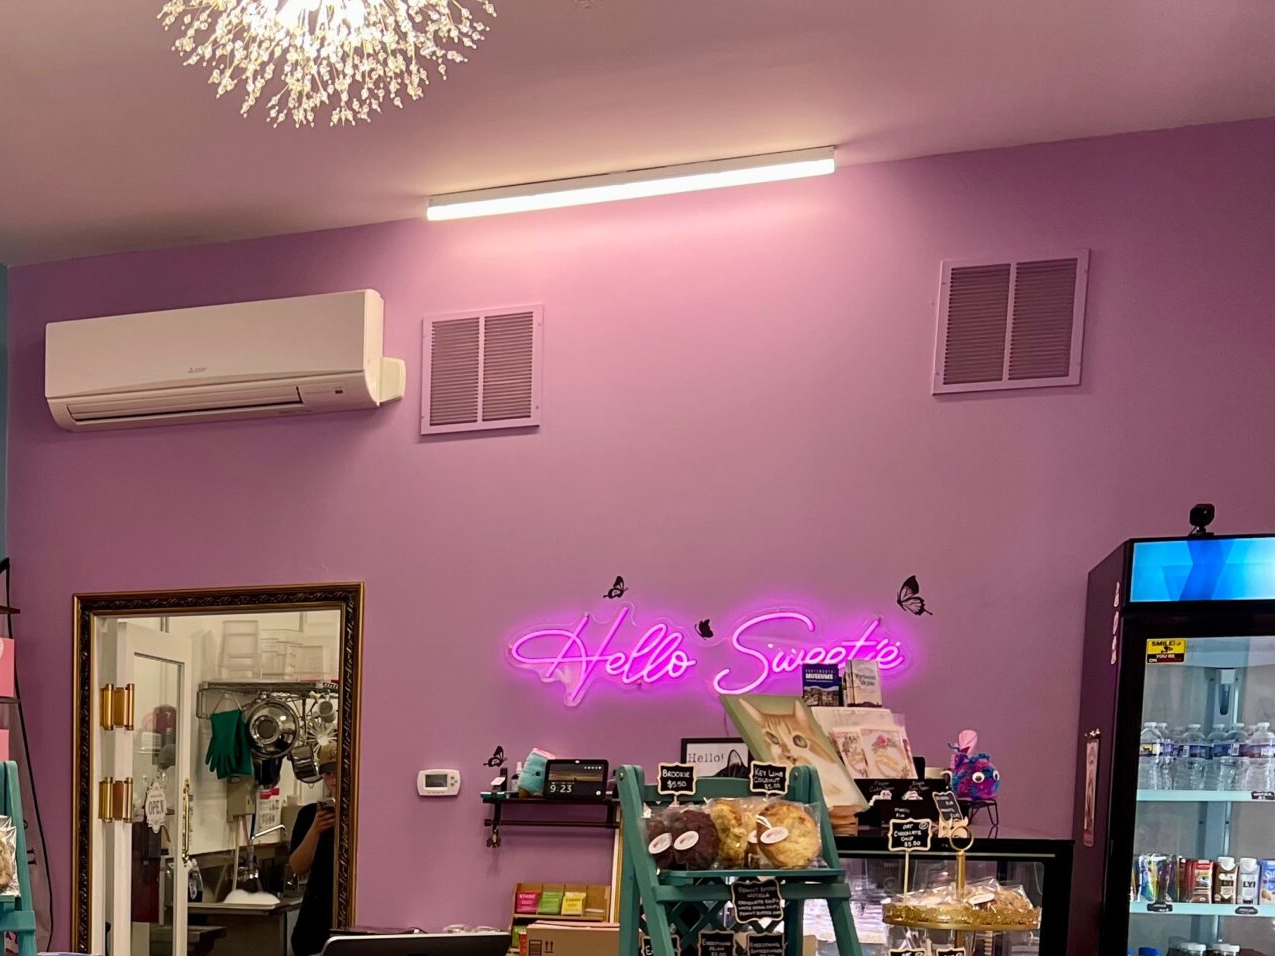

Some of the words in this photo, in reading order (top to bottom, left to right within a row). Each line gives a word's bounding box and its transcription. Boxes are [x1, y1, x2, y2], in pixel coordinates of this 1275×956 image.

[510, 605, 696, 702] Hello
[713, 611, 906, 696] Sweetie
[688, 753, 724, 764] Hello!
[662, 768, 691, 778] BROOKIE
[550, 785, 572, 793] 9:23
[149, 800, 165, 815] OPEN
